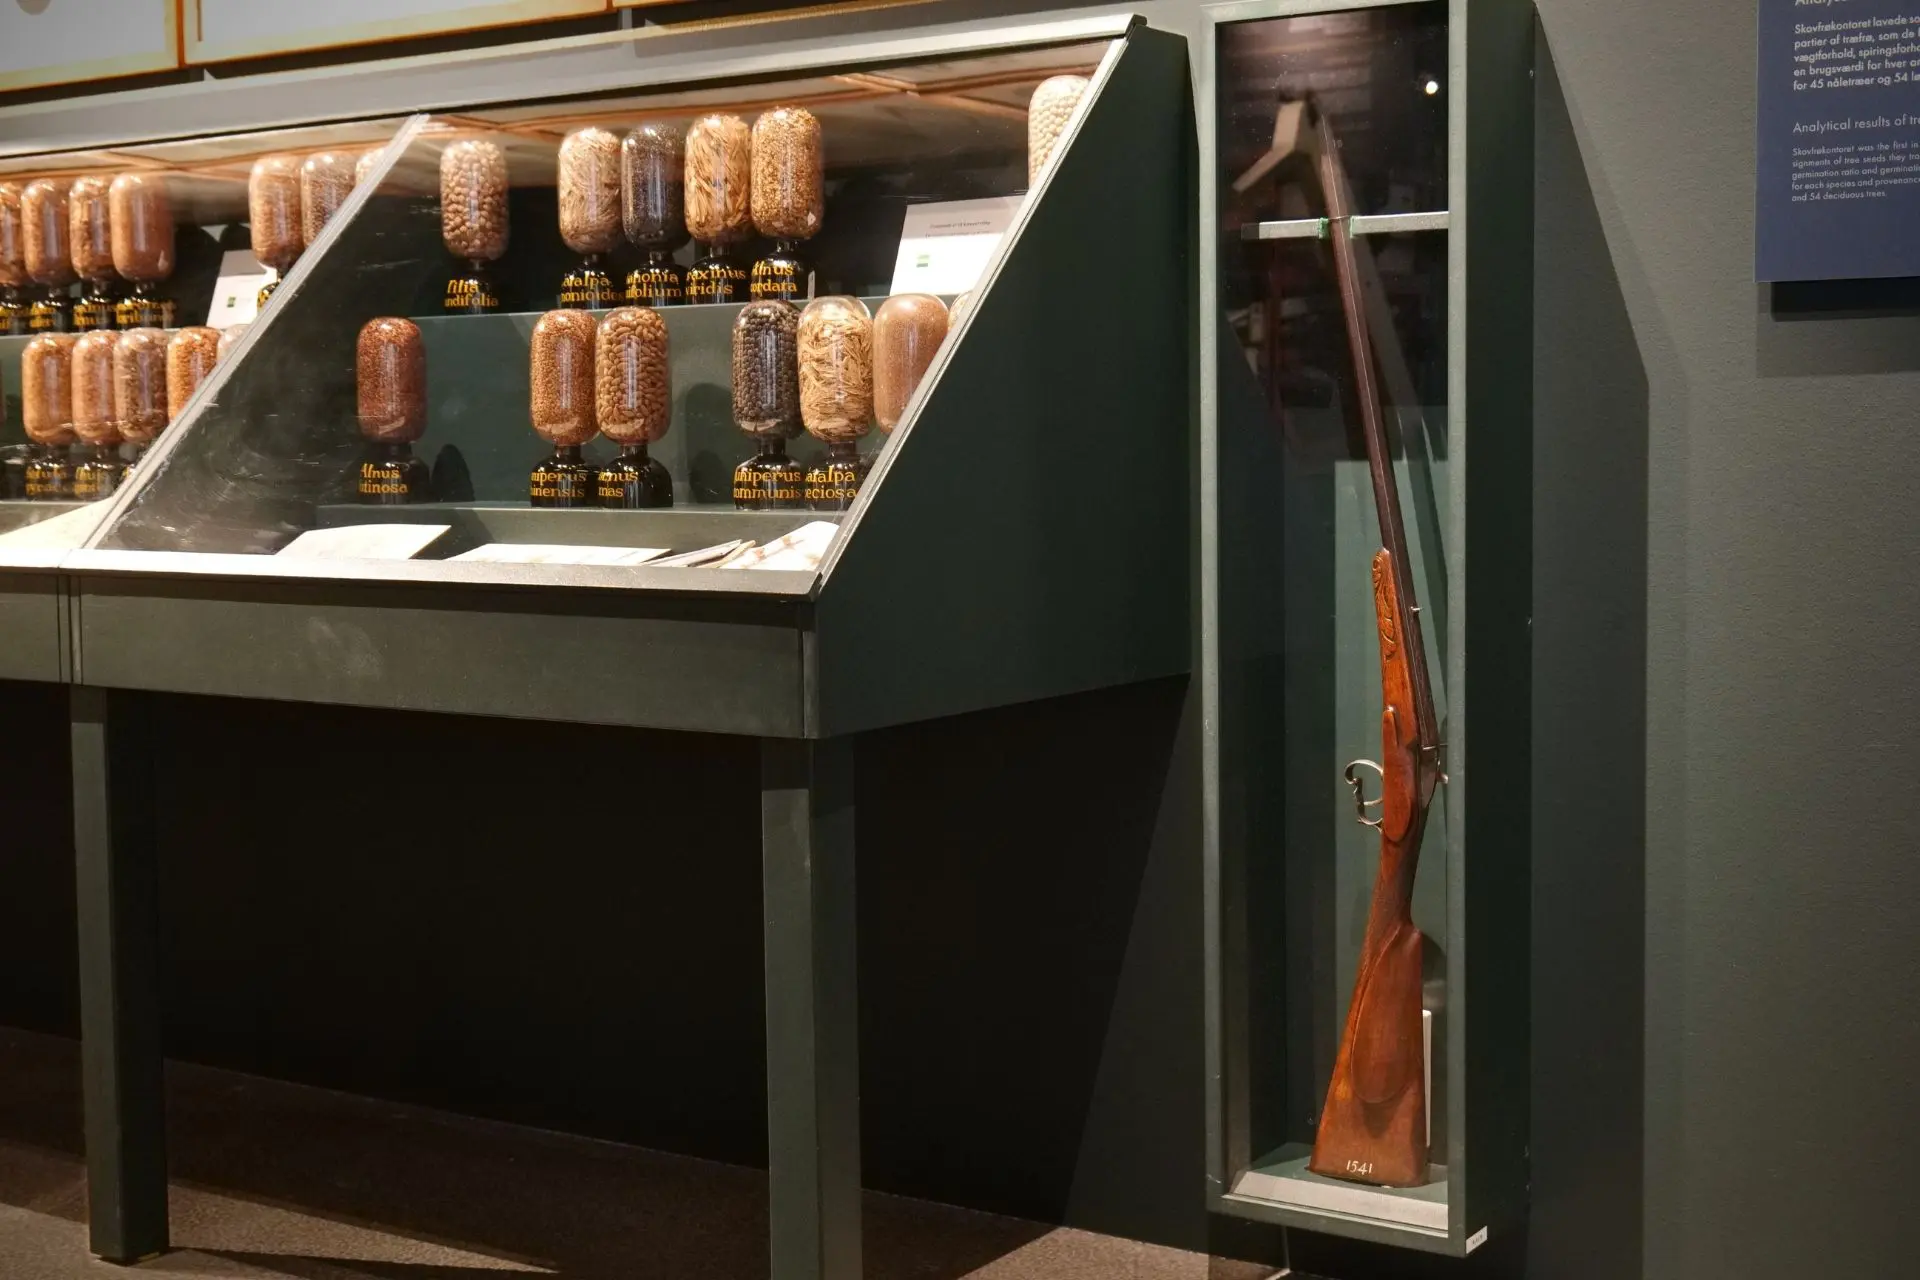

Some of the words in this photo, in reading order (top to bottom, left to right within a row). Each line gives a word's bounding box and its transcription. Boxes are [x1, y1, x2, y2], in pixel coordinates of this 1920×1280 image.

[1873, 15, 1907, 27] lavede
[1794, 38, 1827, 51] partier
[1830, 34, 1840, 45] af
[1902, 28, 1914, 38] de
[1794, 48, 1856, 63] vægtforhold,
[1809, 61, 1864, 76] brugsværdi
[1867, 60, 1881, 70] for
[1885, 58, 1906, 68] hver
[1793, 80, 1807, 91] for
[1810, 80, 1824, 89] 45
[1827, 77, 1874, 87] nåletræer
[1877, 77, 1890, 86] og
[1894, 72, 1907, 83] 54
[1793, 117, 1850, 134] Analytical
[1854, 115, 1890, 129] results
[1894, 113, 1908, 126] of
[1877, 142, 1890, 150] the
[1893, 140, 1908, 150] first
[1833, 156, 1842, 165] of
[1844, 156, 1860, 164] tree
[1863, 154, 1886, 163] seeds
[1889, 153, 1906, 162] they
[1792, 169, 1839, 180] germination
[1841, 168, 1860, 176] ratio
[1862, 165, 1878, 174] and
[1792, 181, 1803, 190] for
[1805, 180, 1825, 189] each
[1857, 178, 1873, 187] and
[1792, 192, 1807, 201] and
[1810, 192, 1821, 200] 54
[1823, 191, 1864, 200] deciduous
[1346, 1159, 1373, 1175] 1541
